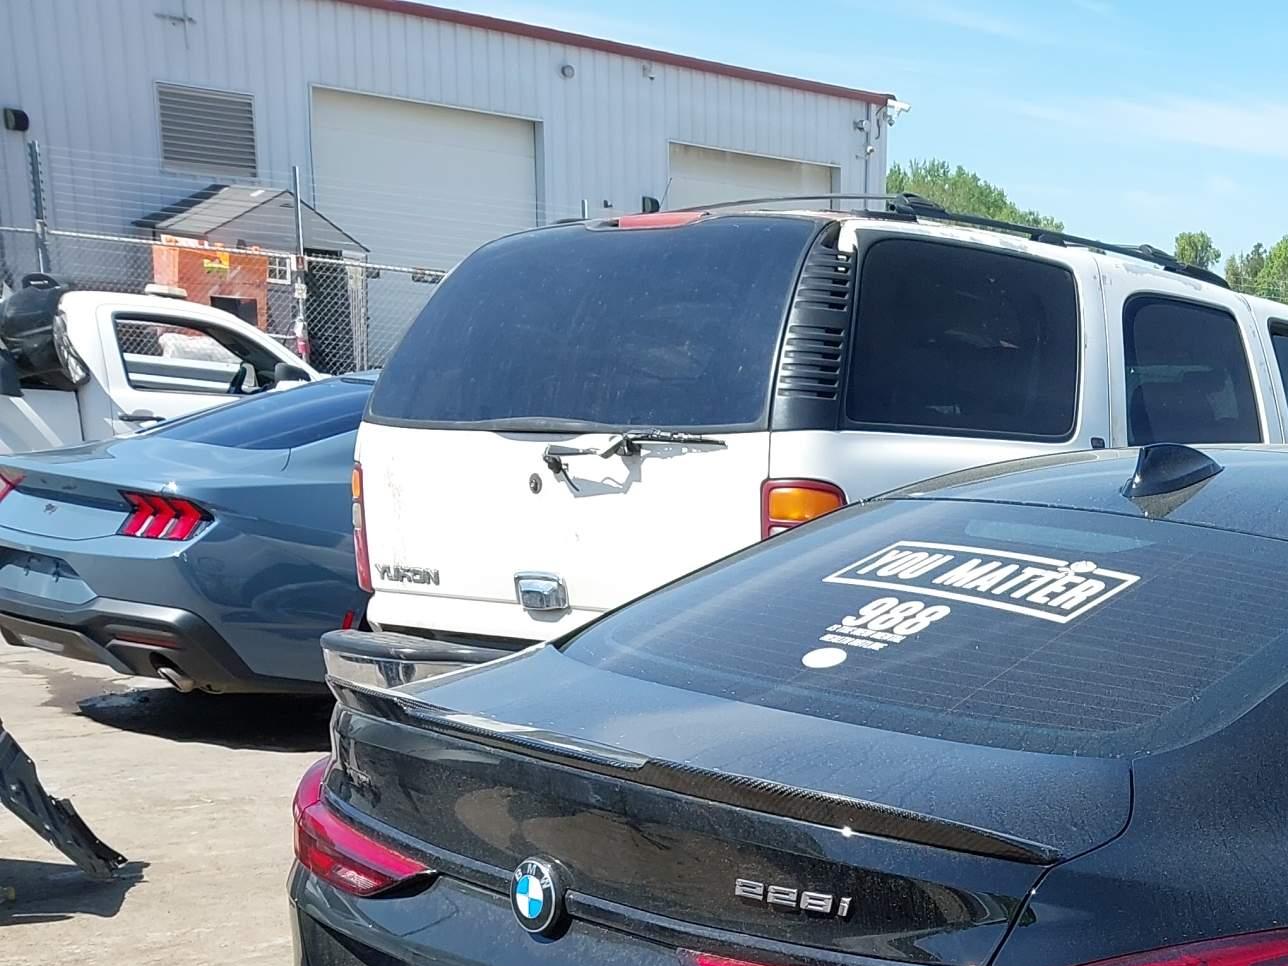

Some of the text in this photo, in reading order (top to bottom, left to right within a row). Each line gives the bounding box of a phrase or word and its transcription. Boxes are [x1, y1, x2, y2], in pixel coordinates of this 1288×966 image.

[374, 563, 440, 586] YUKON
[856, 549, 1106, 611] YOU MATTER
[841, 596, 951, 636] 988
[514, 863, 552, 890] BMW
[735, 878, 853, 917] 228i
